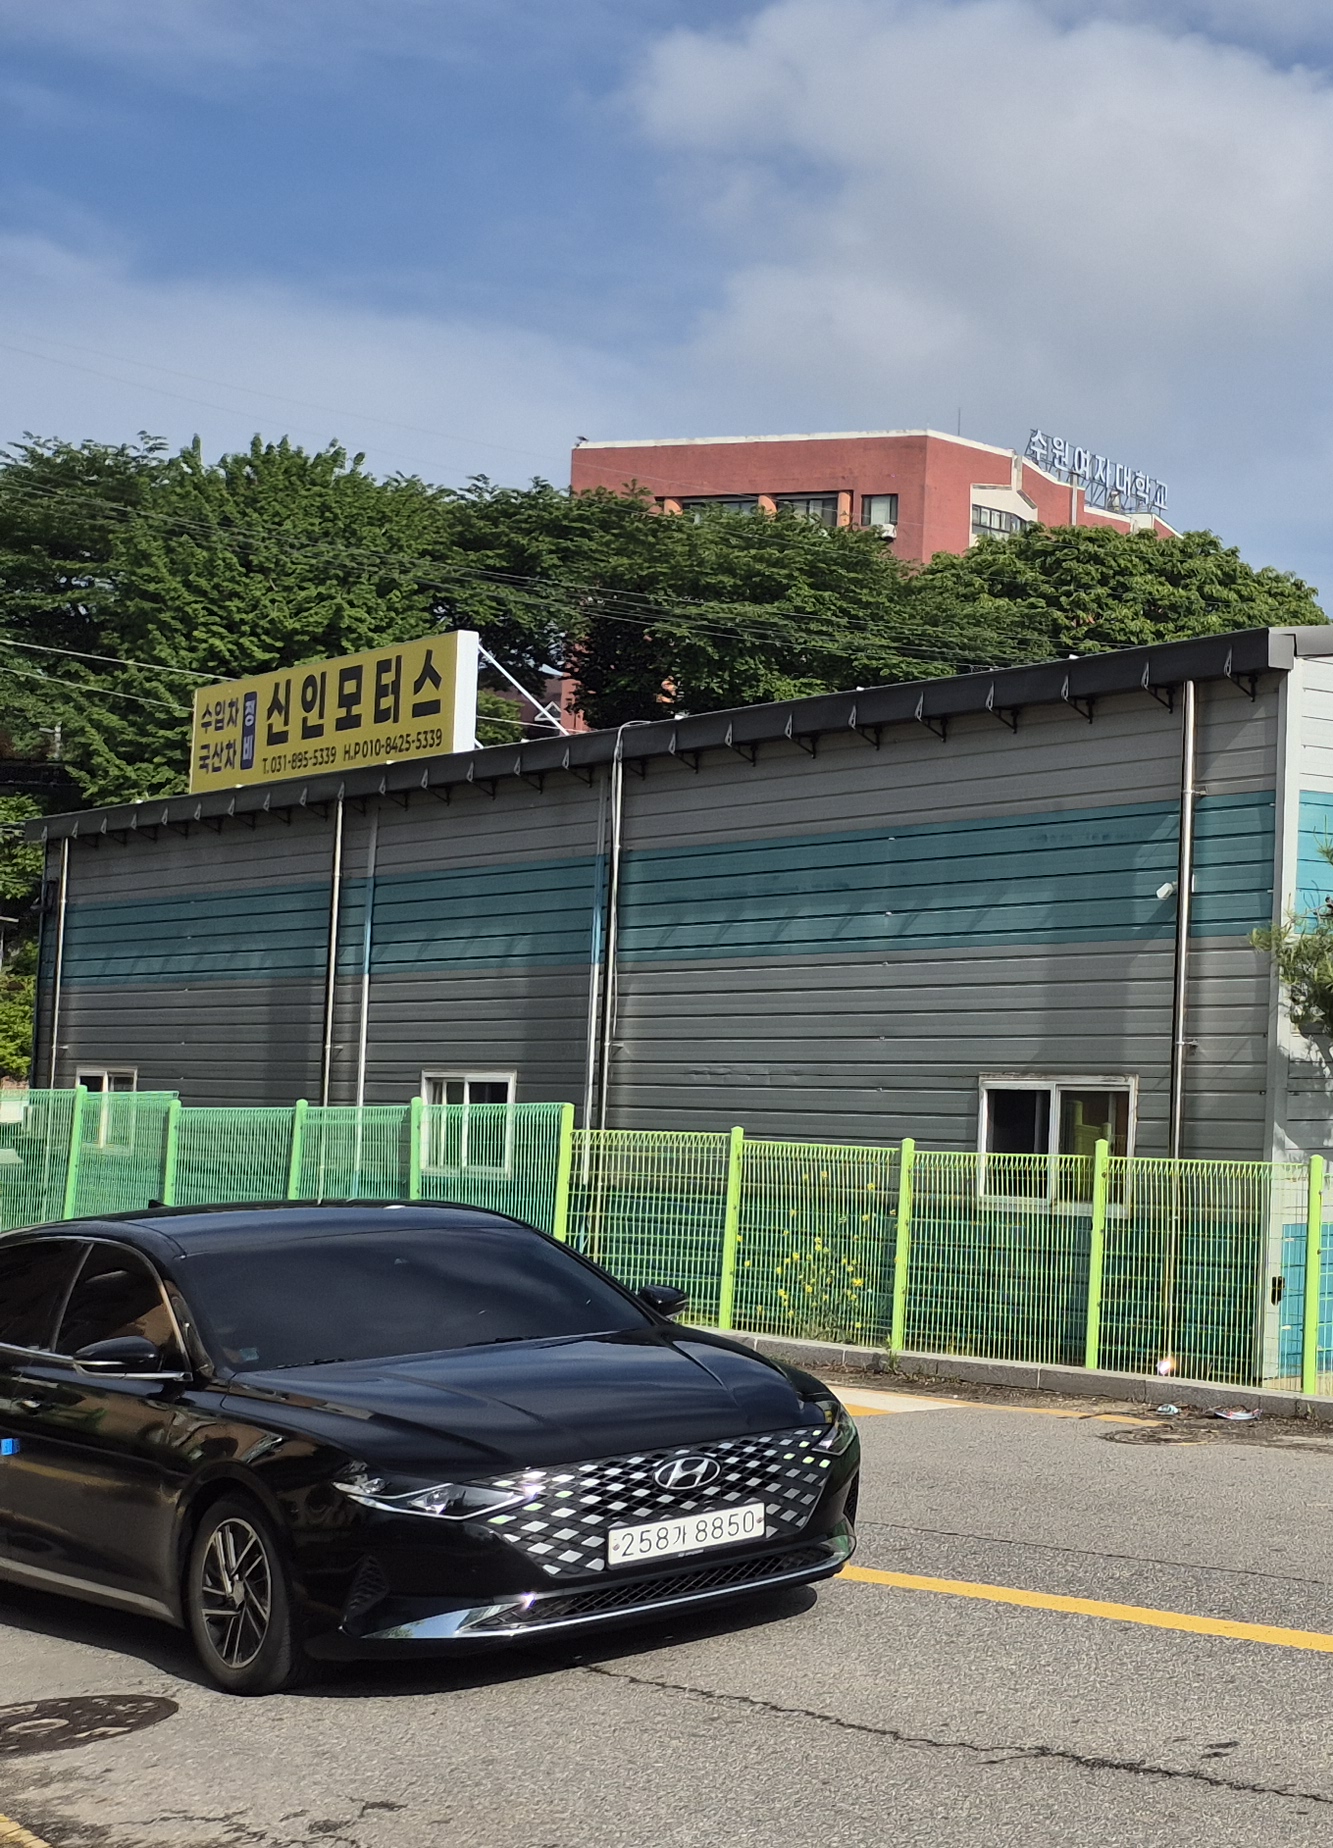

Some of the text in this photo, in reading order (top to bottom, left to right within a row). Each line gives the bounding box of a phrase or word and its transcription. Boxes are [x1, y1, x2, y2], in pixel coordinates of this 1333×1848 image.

[1030, 429, 1169, 511] 수원여자대학교
[200, 696, 240, 735] 수입차
[266, 648, 443, 747] 신인모터스
[198, 738, 237, 775] 국산차
[242, 699, 256, 761] 정비
[621, 1510, 755, 1558] 258가 8850
